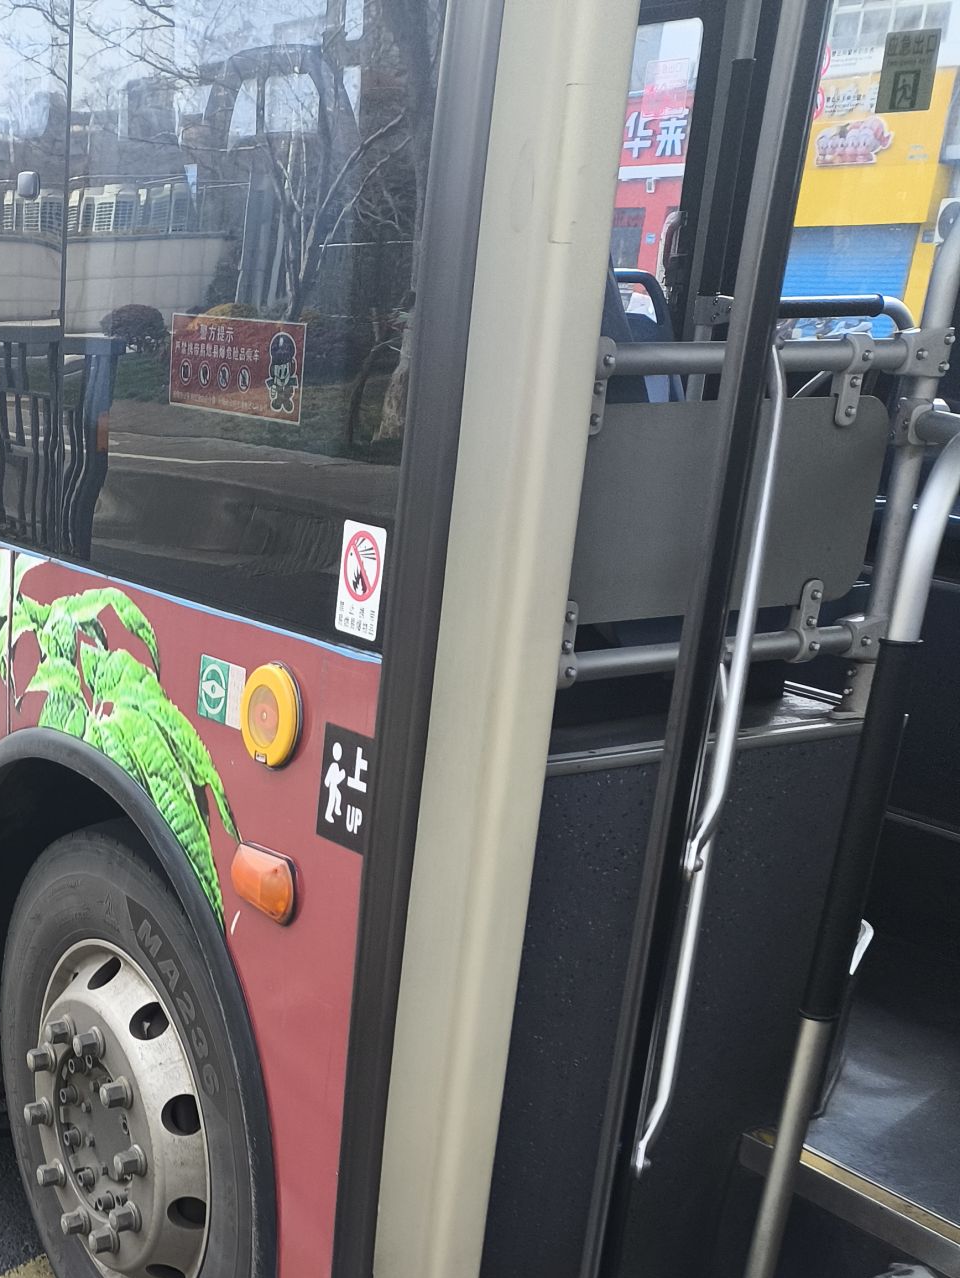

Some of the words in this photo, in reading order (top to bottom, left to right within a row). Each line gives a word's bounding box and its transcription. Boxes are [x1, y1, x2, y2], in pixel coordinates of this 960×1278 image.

[886, 34, 938, 56] 应急出口
[200, 324, 234, 343] 警方提示
[347, 746, 368, 793] 上
[346, 804, 363, 834] UP
